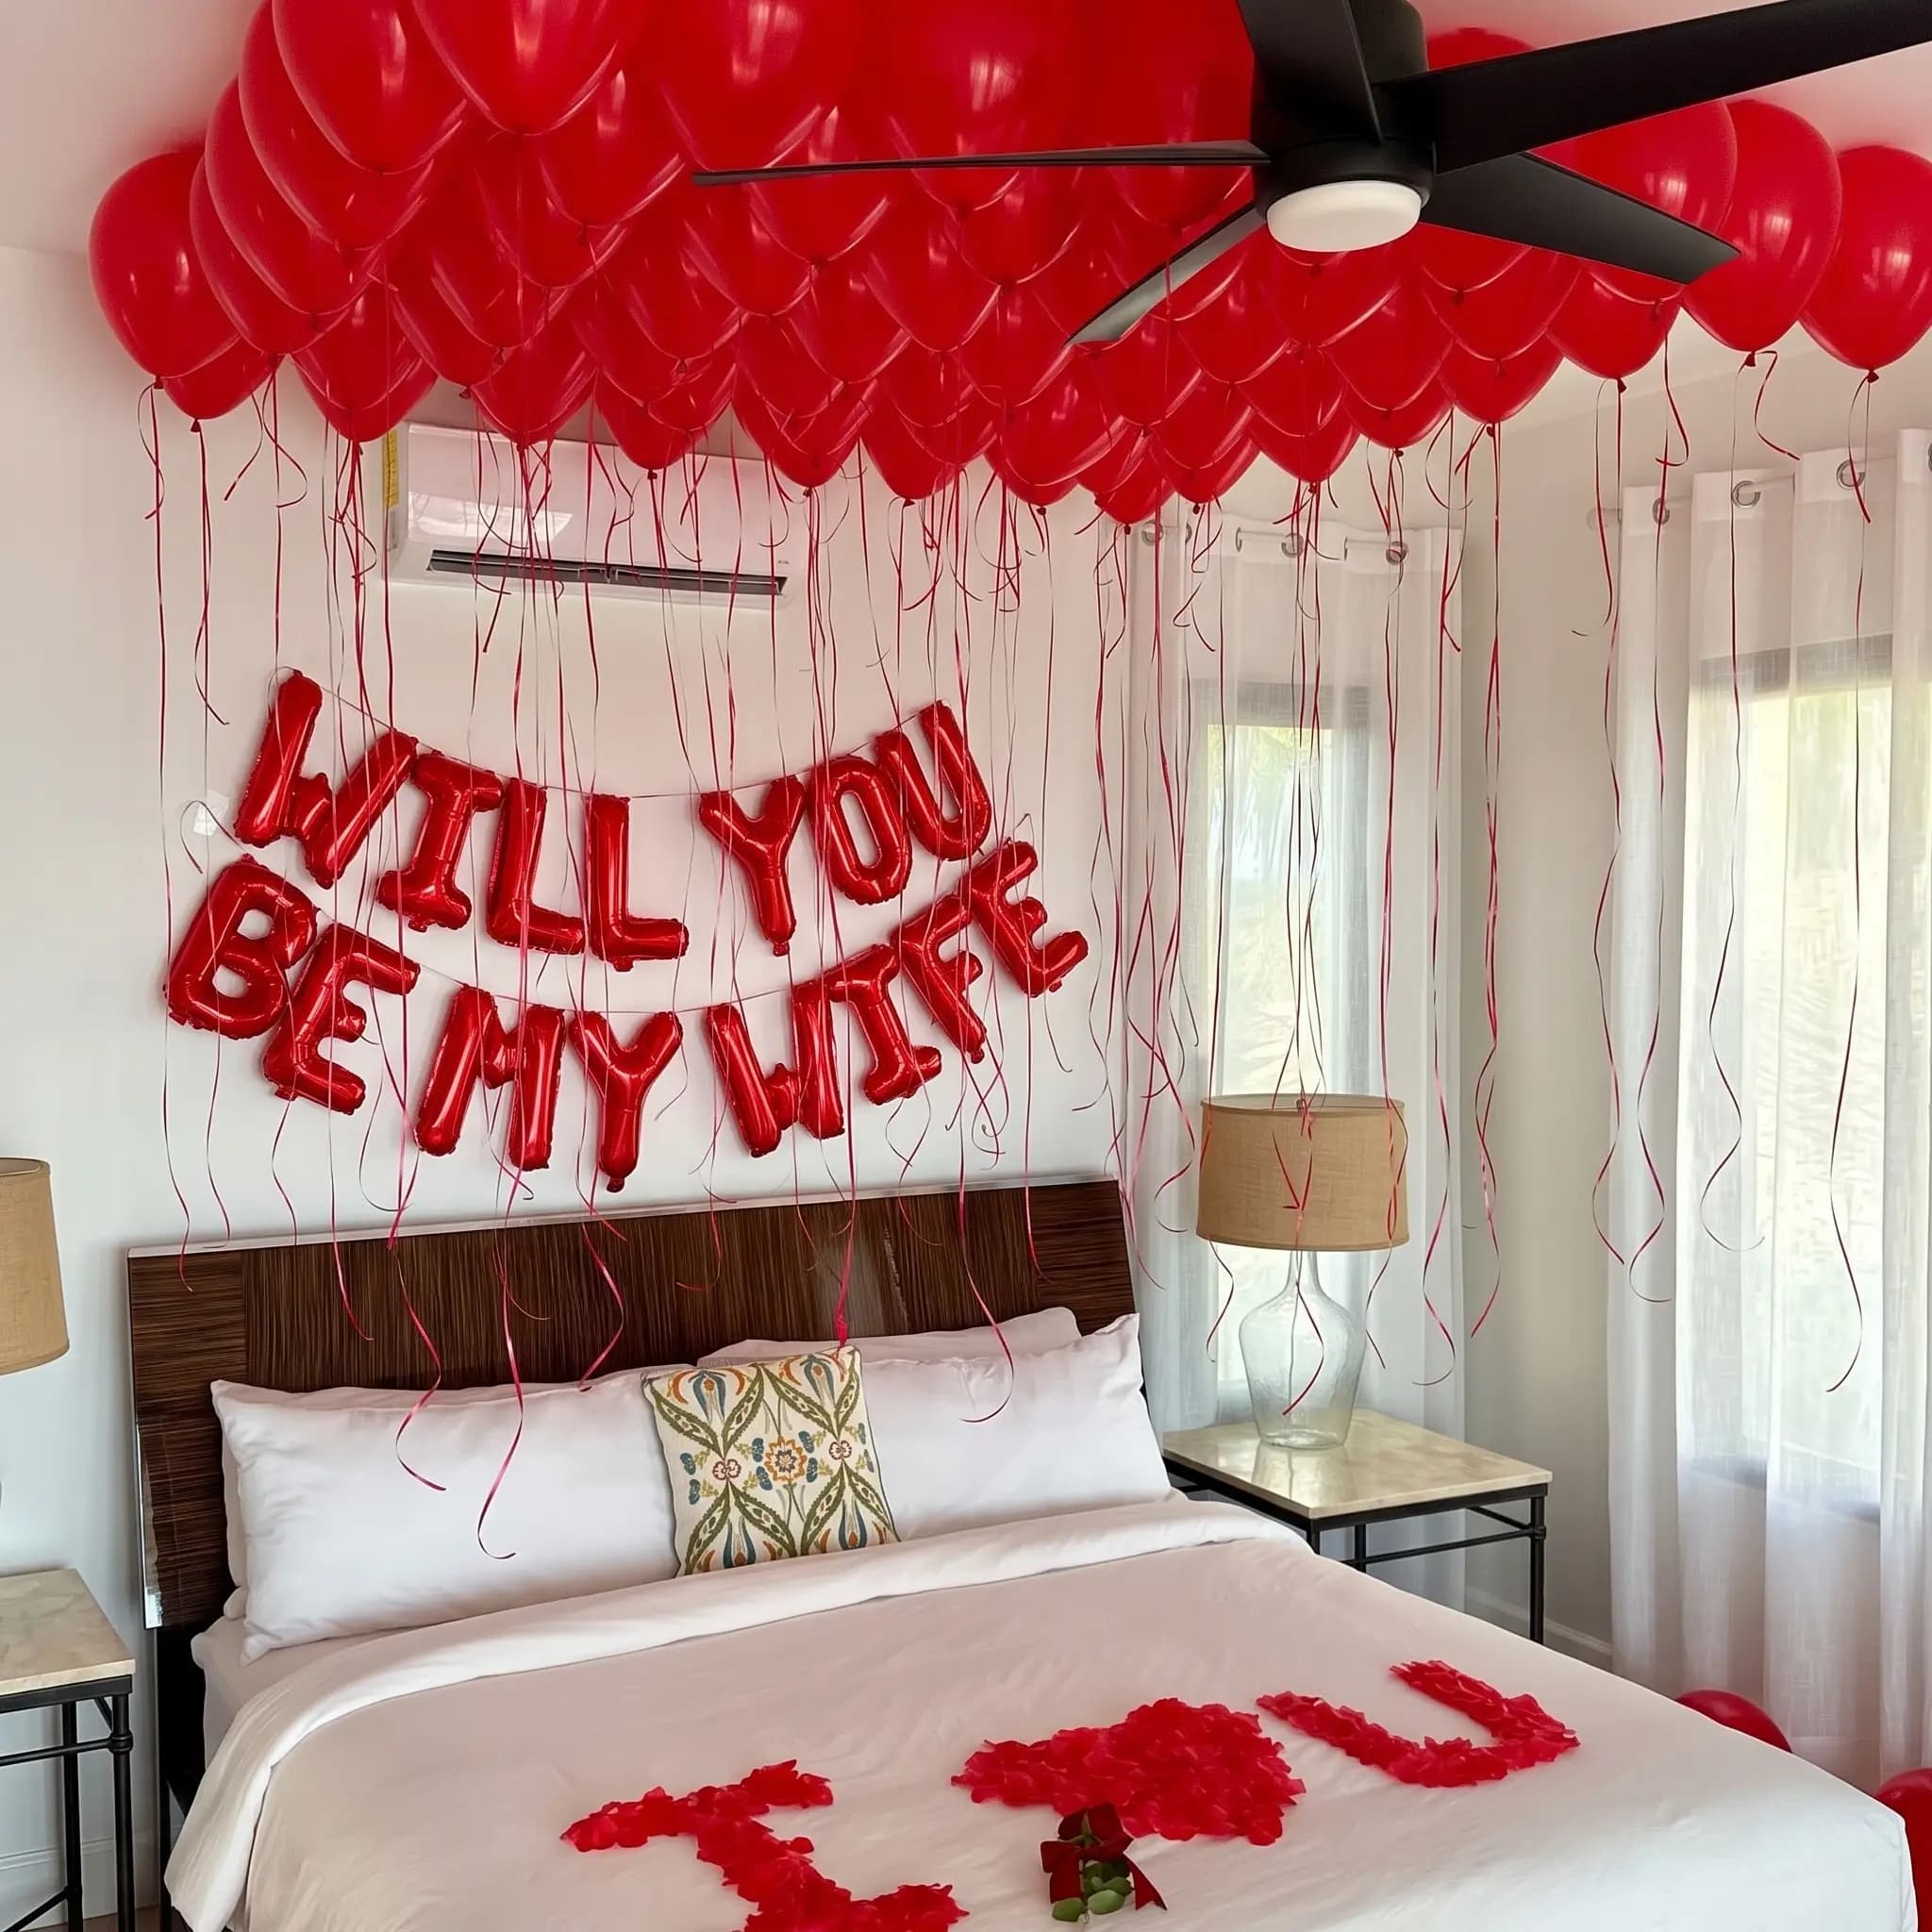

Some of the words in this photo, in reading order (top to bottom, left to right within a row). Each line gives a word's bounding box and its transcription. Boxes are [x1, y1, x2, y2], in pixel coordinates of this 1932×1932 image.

[234, 670, 690, 972] WILL
[699, 700, 992, 955] YOU
[164, 856, 419, 1115] BE
[416, 983, 681, 1193] MY
[704, 841, 1088, 1157] WIFE
